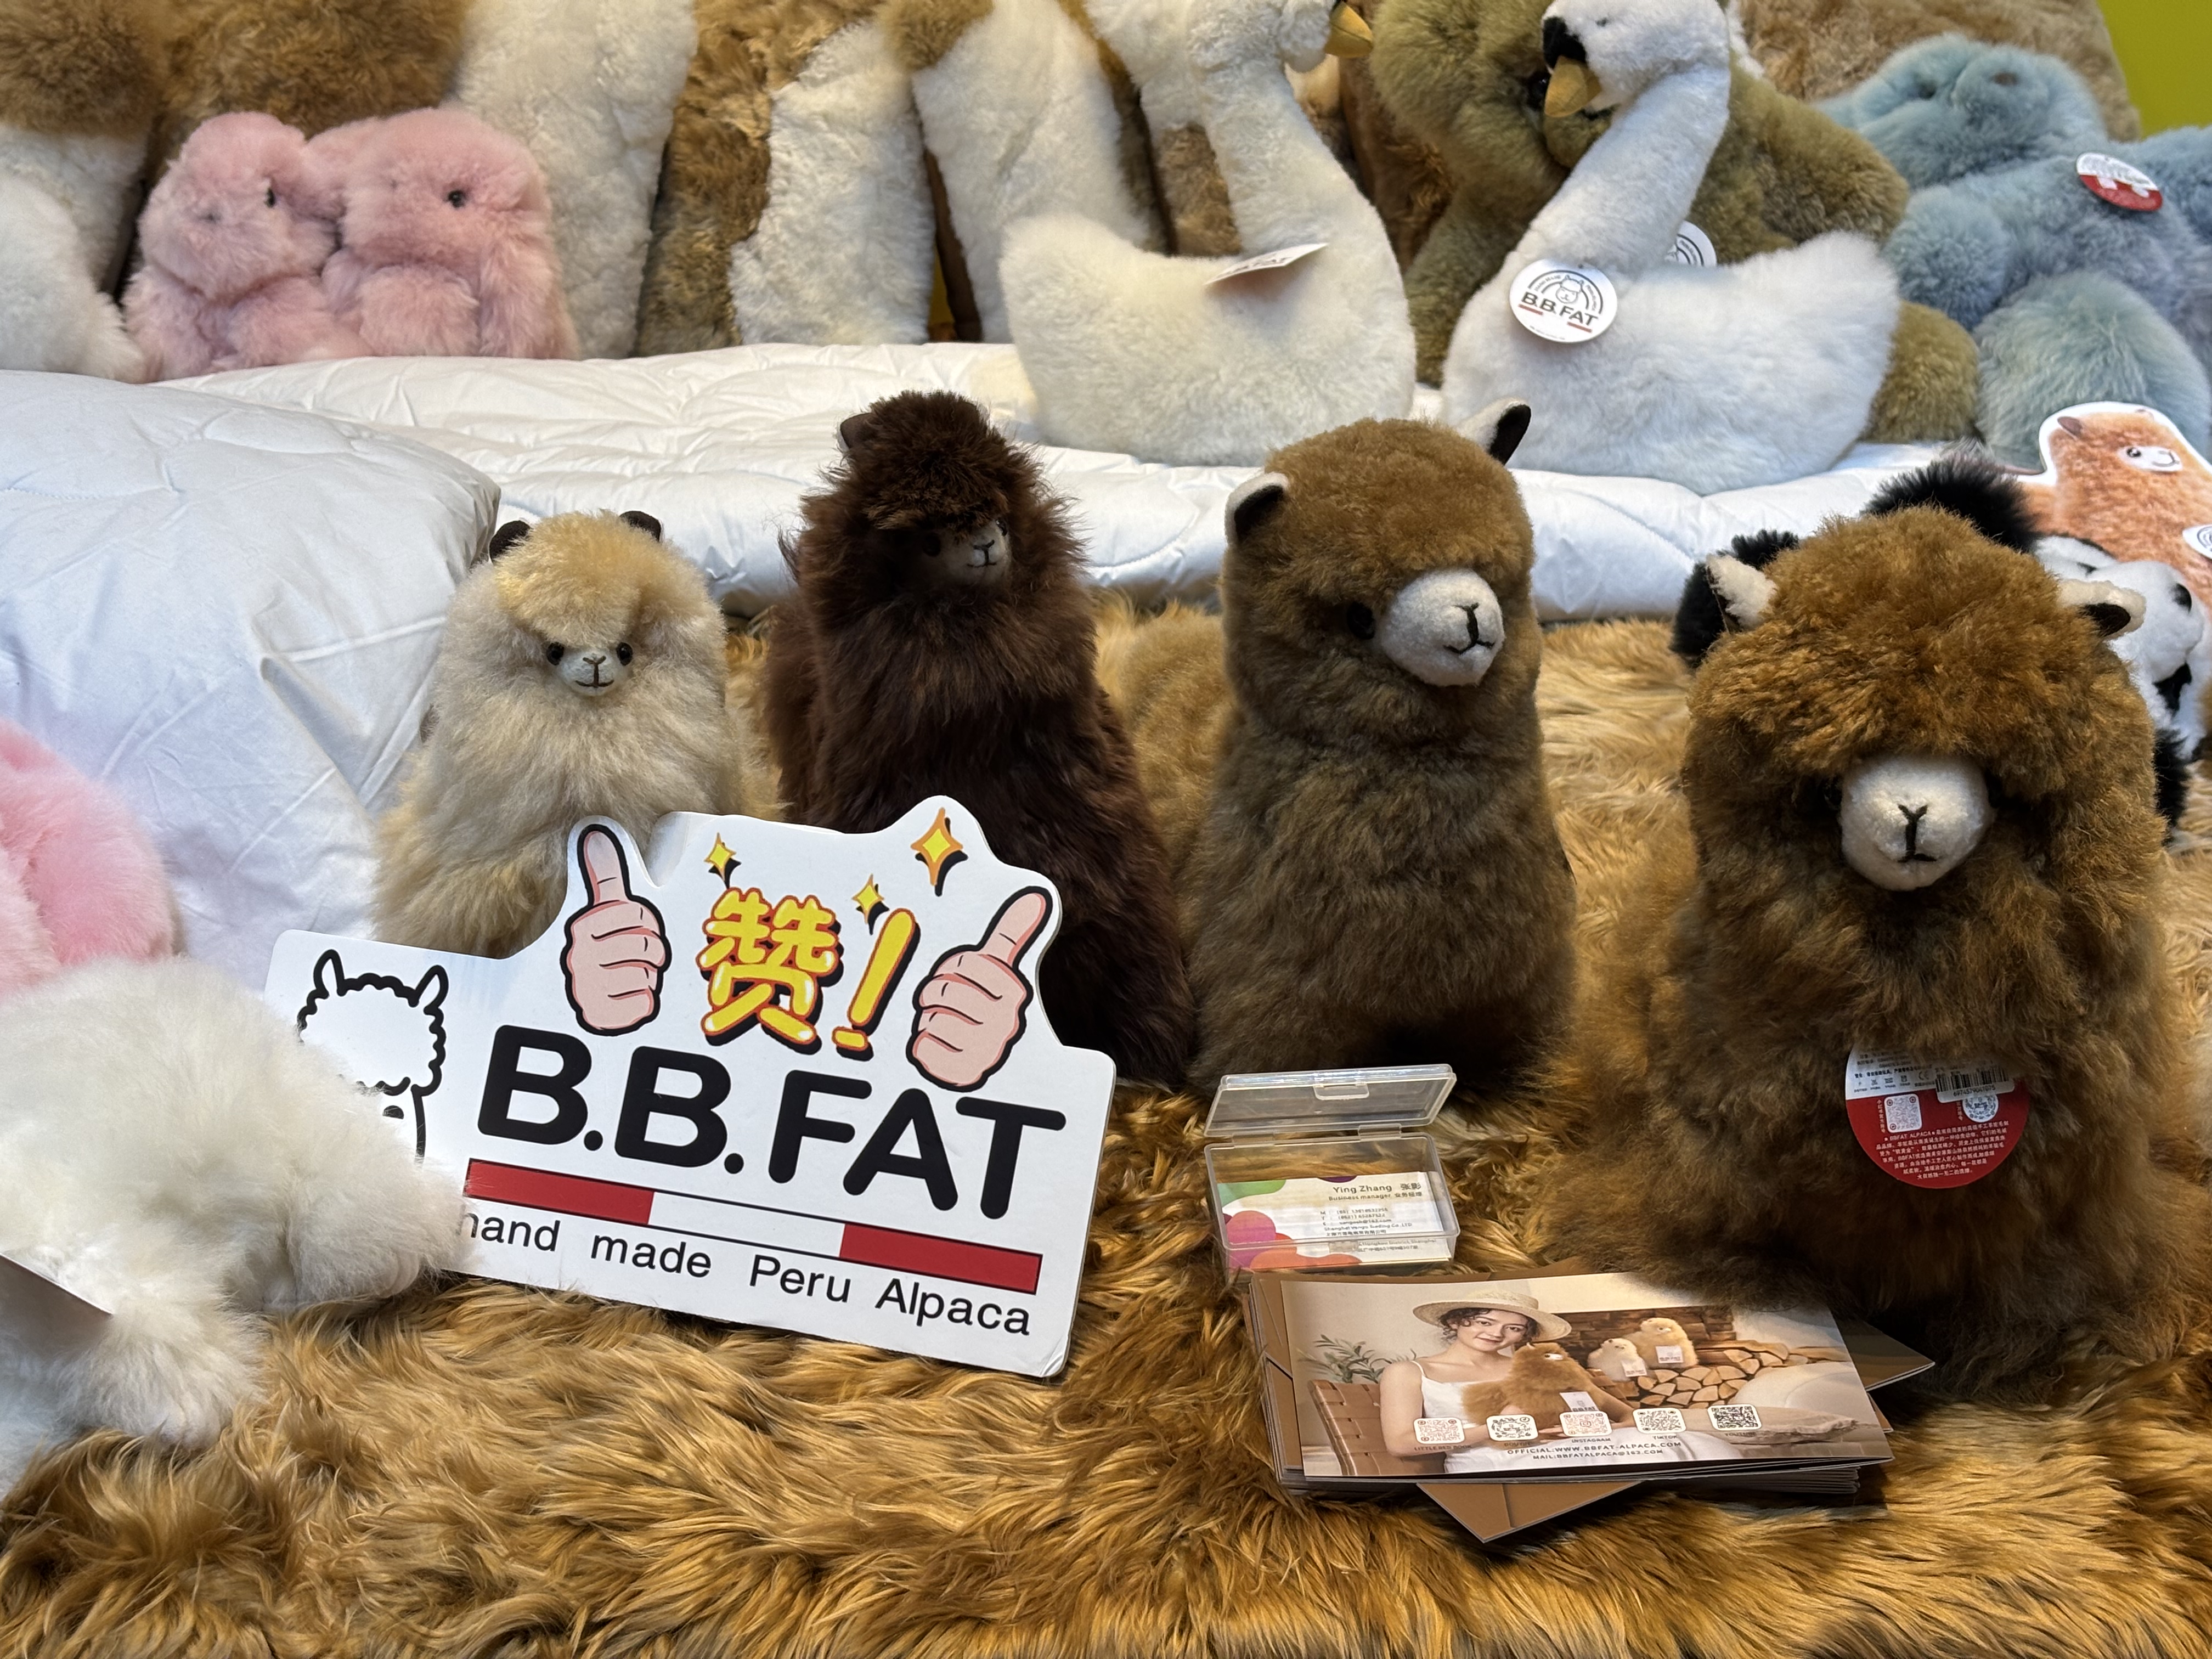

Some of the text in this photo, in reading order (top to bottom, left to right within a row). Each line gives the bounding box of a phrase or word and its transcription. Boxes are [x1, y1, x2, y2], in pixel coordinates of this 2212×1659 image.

[1521, 291, 1599, 326] B.B.FAT
[477, 1024, 1067, 1220] B.B.FAT
[1358, 1184, 1392, 1193] Zhang
[590, 1234, 712, 1278] made
[749, 1254, 851, 1303] Peru
[874, 1277, 1030, 1336] Alpaca
